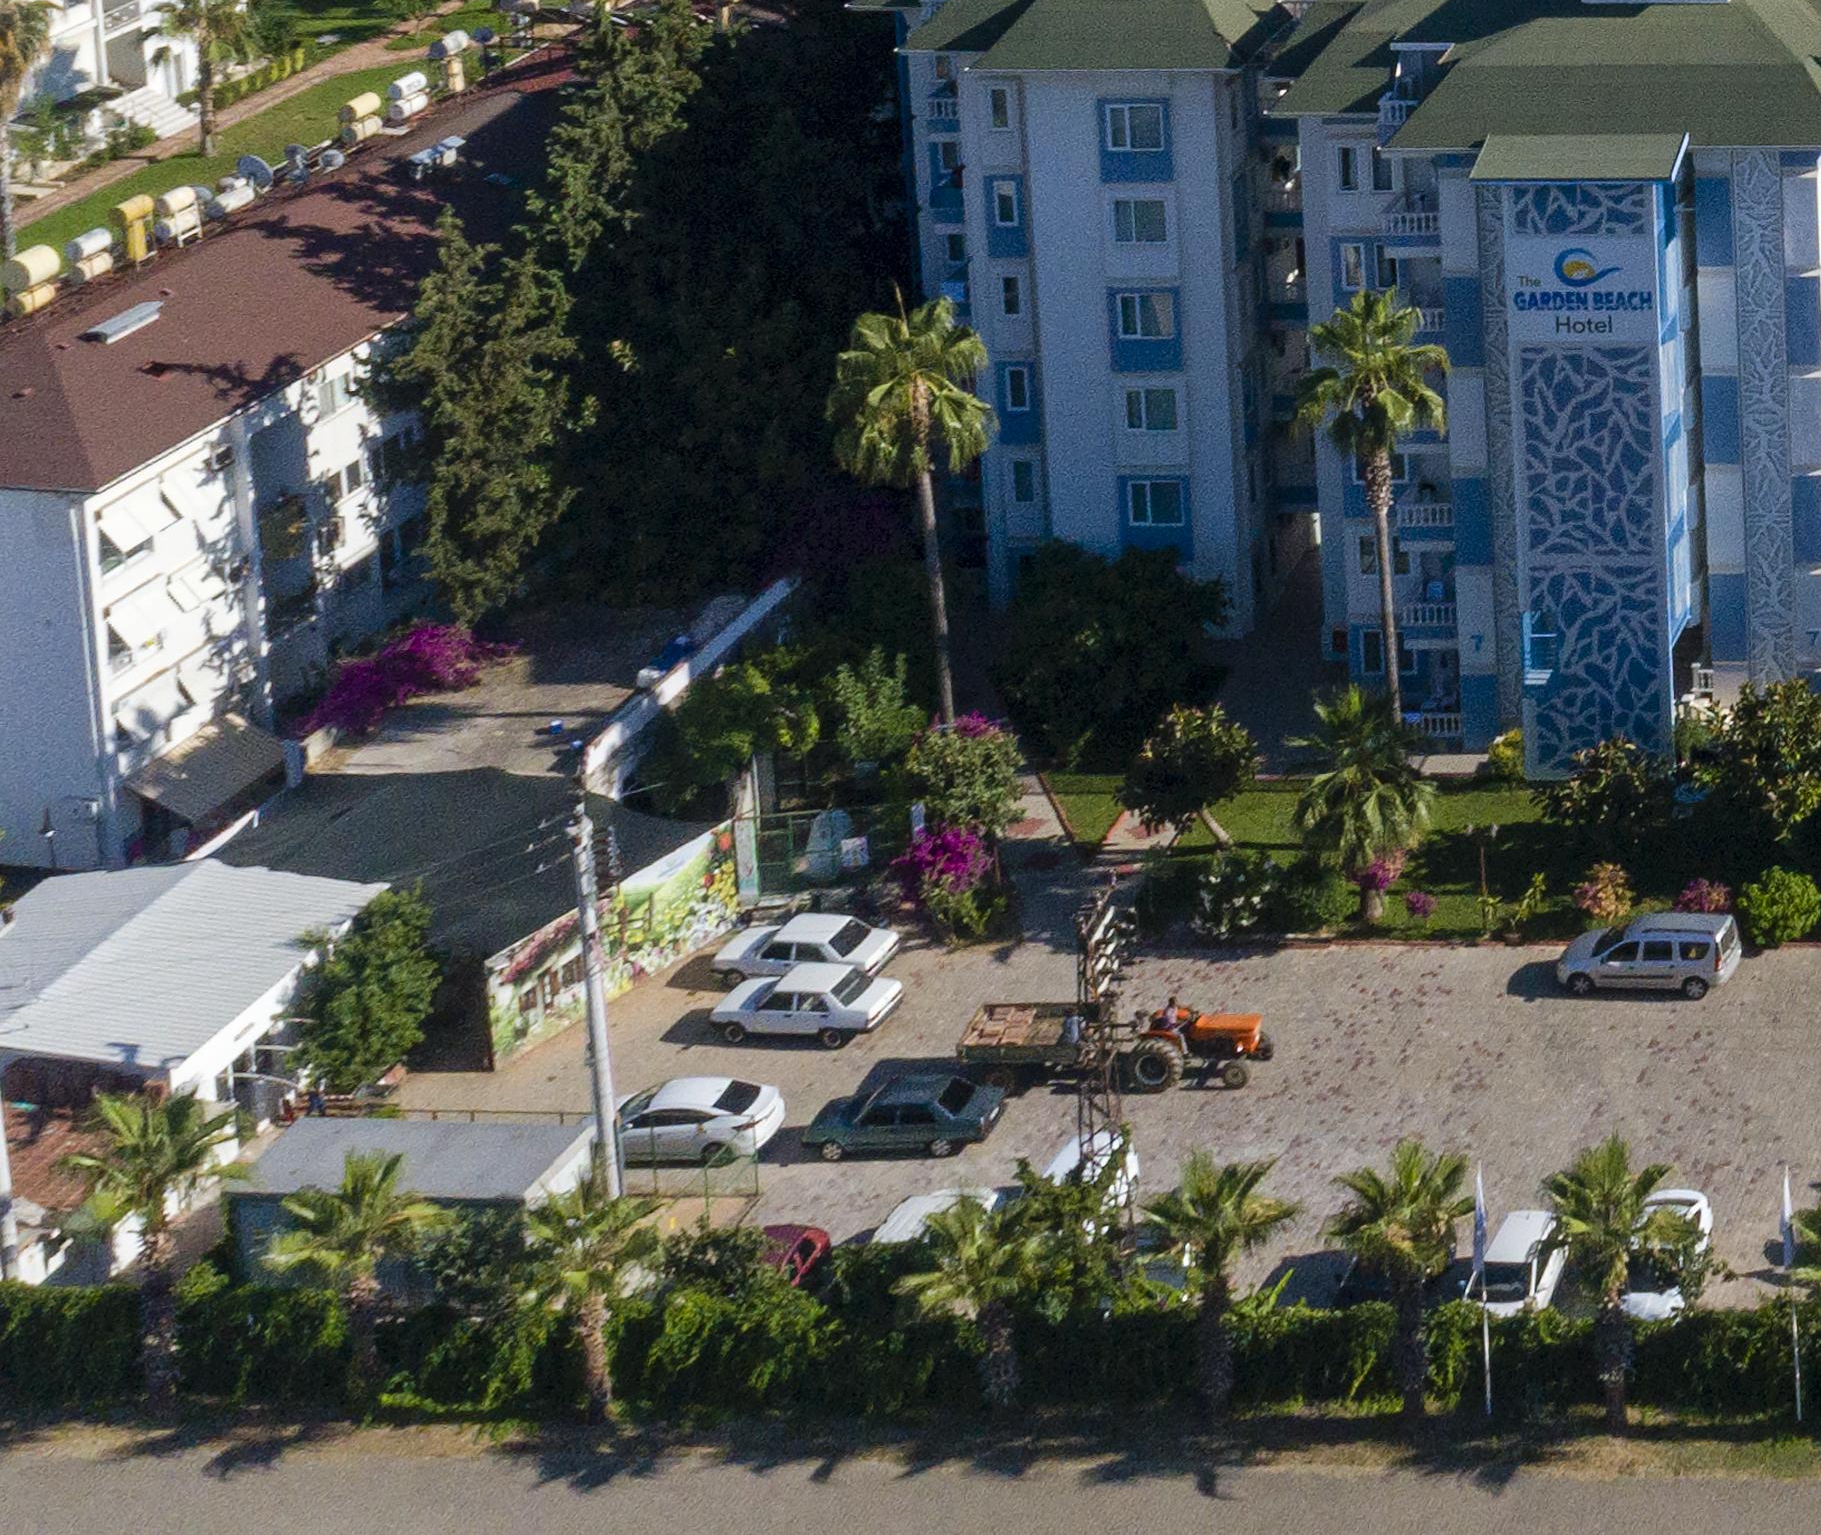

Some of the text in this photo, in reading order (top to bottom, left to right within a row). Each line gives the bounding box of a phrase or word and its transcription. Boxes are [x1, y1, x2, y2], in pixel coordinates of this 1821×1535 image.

[1518, 276, 1542, 287] The
[1513, 291, 1653, 311] GARDEN BEACH
[1555, 315, 1613, 334] Hotel
